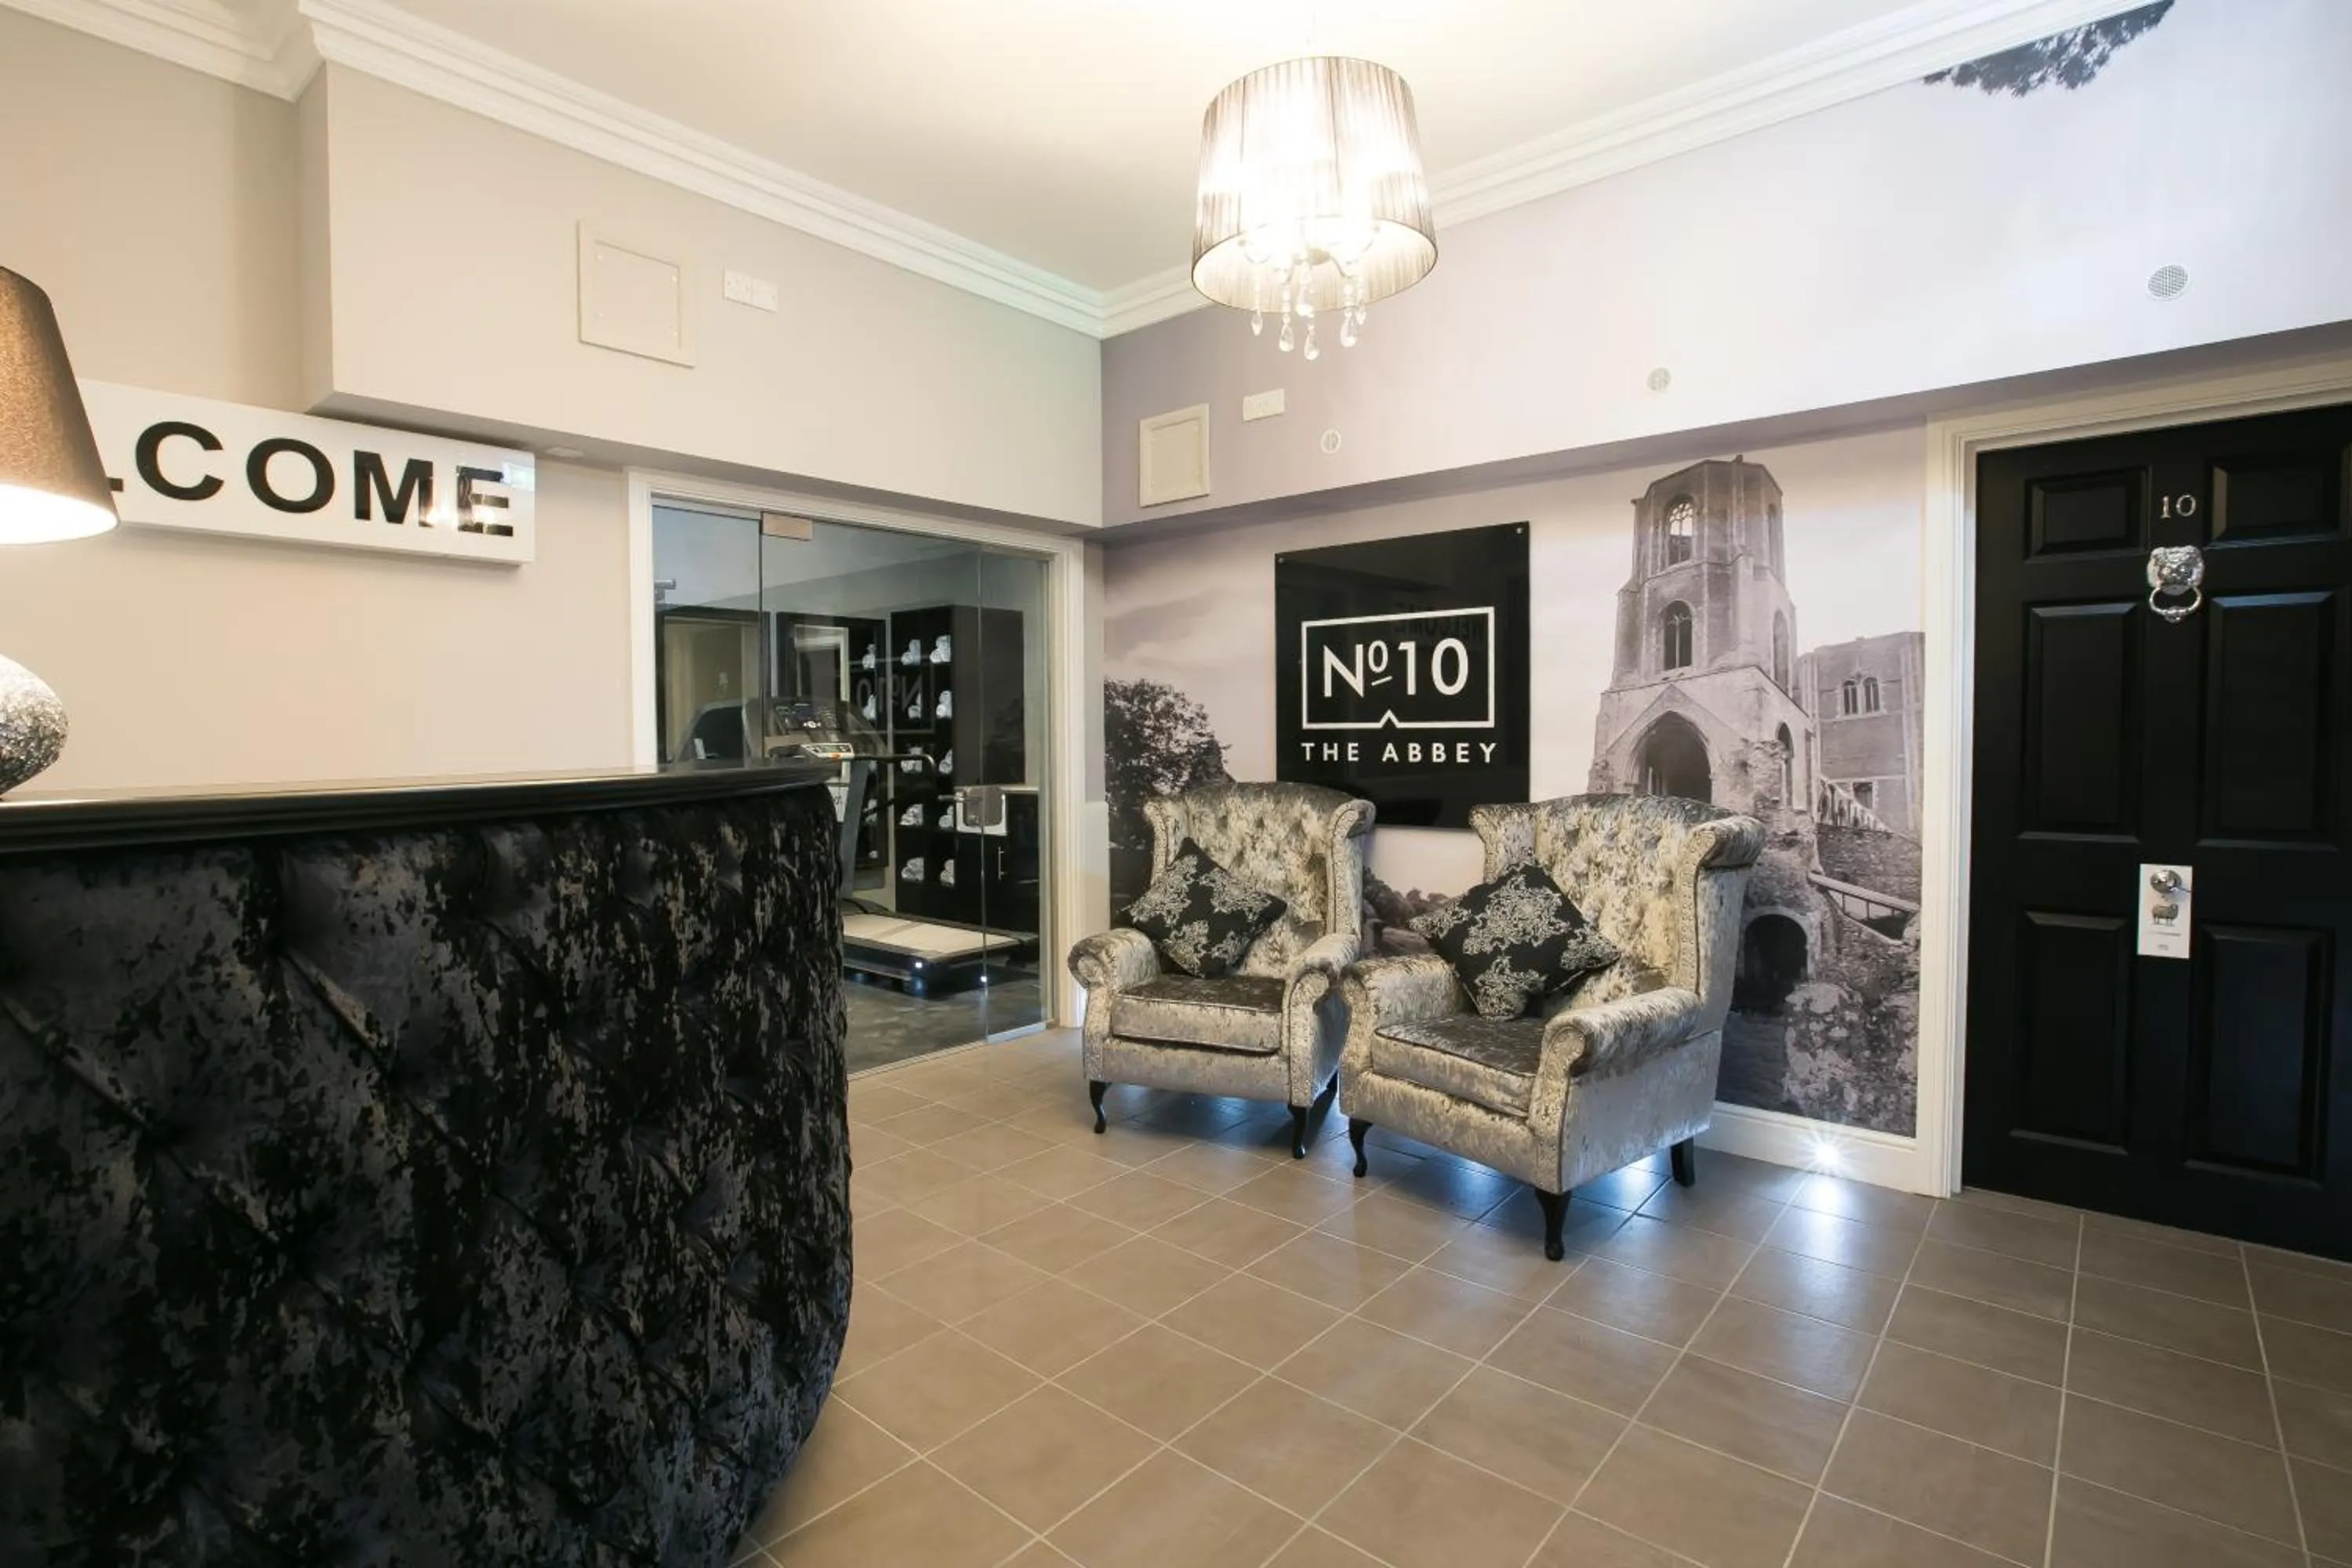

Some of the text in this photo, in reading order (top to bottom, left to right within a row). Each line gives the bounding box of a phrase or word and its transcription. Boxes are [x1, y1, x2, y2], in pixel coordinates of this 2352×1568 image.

[107, 421, 514, 536] COME
[2160, 494, 2196, 518] 10
[1301, 742, 1497, 764] THE ABBEY
